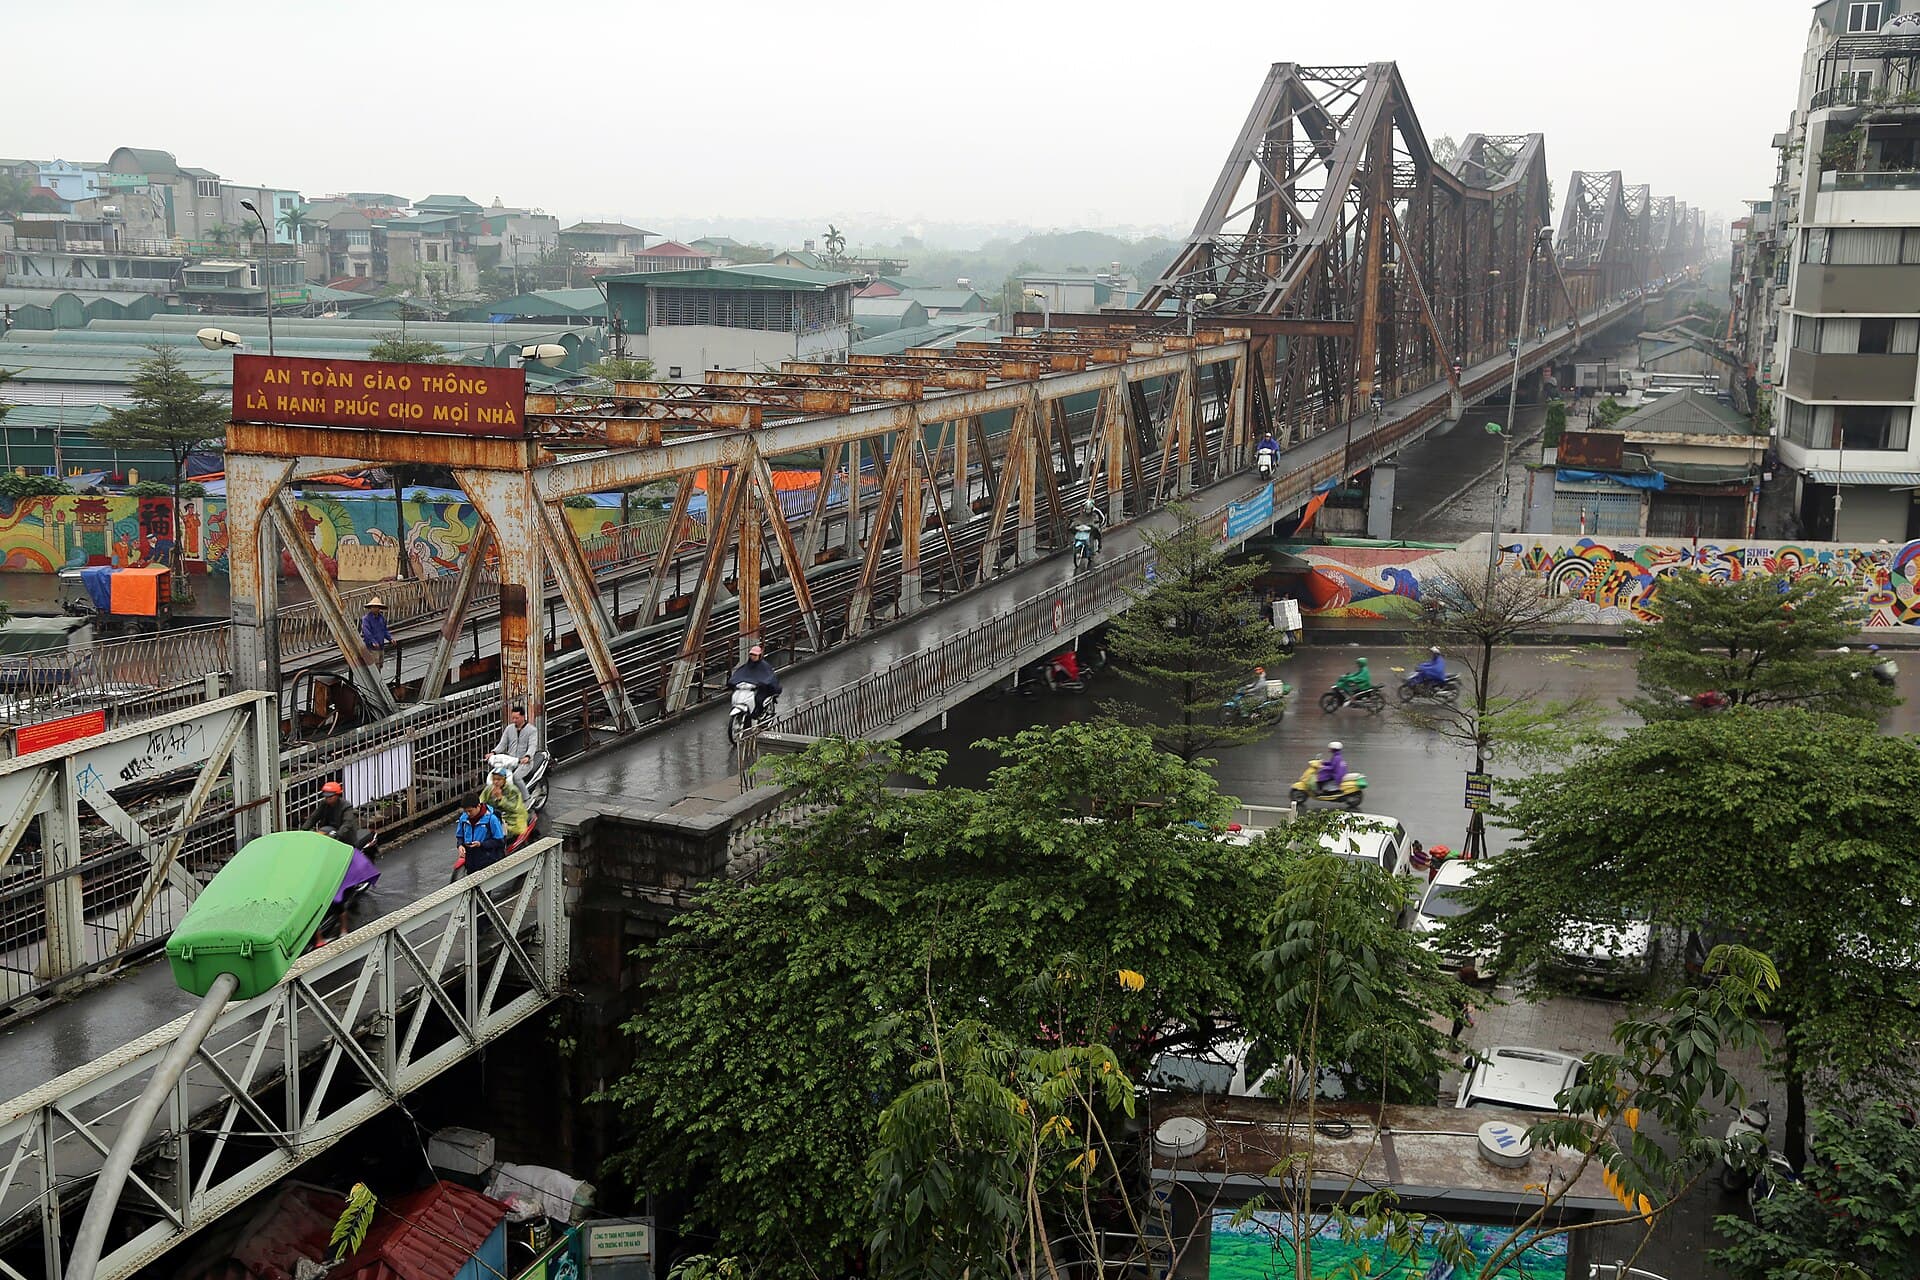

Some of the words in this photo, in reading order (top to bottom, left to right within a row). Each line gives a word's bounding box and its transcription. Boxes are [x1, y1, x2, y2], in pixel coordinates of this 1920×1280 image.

[264, 368, 290, 385] AN
[301, 366, 353, 388] TOÀN
[364, 370, 411, 391] GIAO
[421, 372, 488, 395] THÔNG
[246, 388, 268, 410] LÀ
[277, 395, 325, 416] HẠNH
[334, 394, 379, 417] PHÚC
[388, 402, 423, 419] CHO
[432, 402, 468, 426] MỌI
[477, 402, 516, 425] NHÀ
[1747, 548, 1769, 557] SINH
[1747, 558, 1760, 566] RA
[1488, 1127, 1517, 1149] WC
